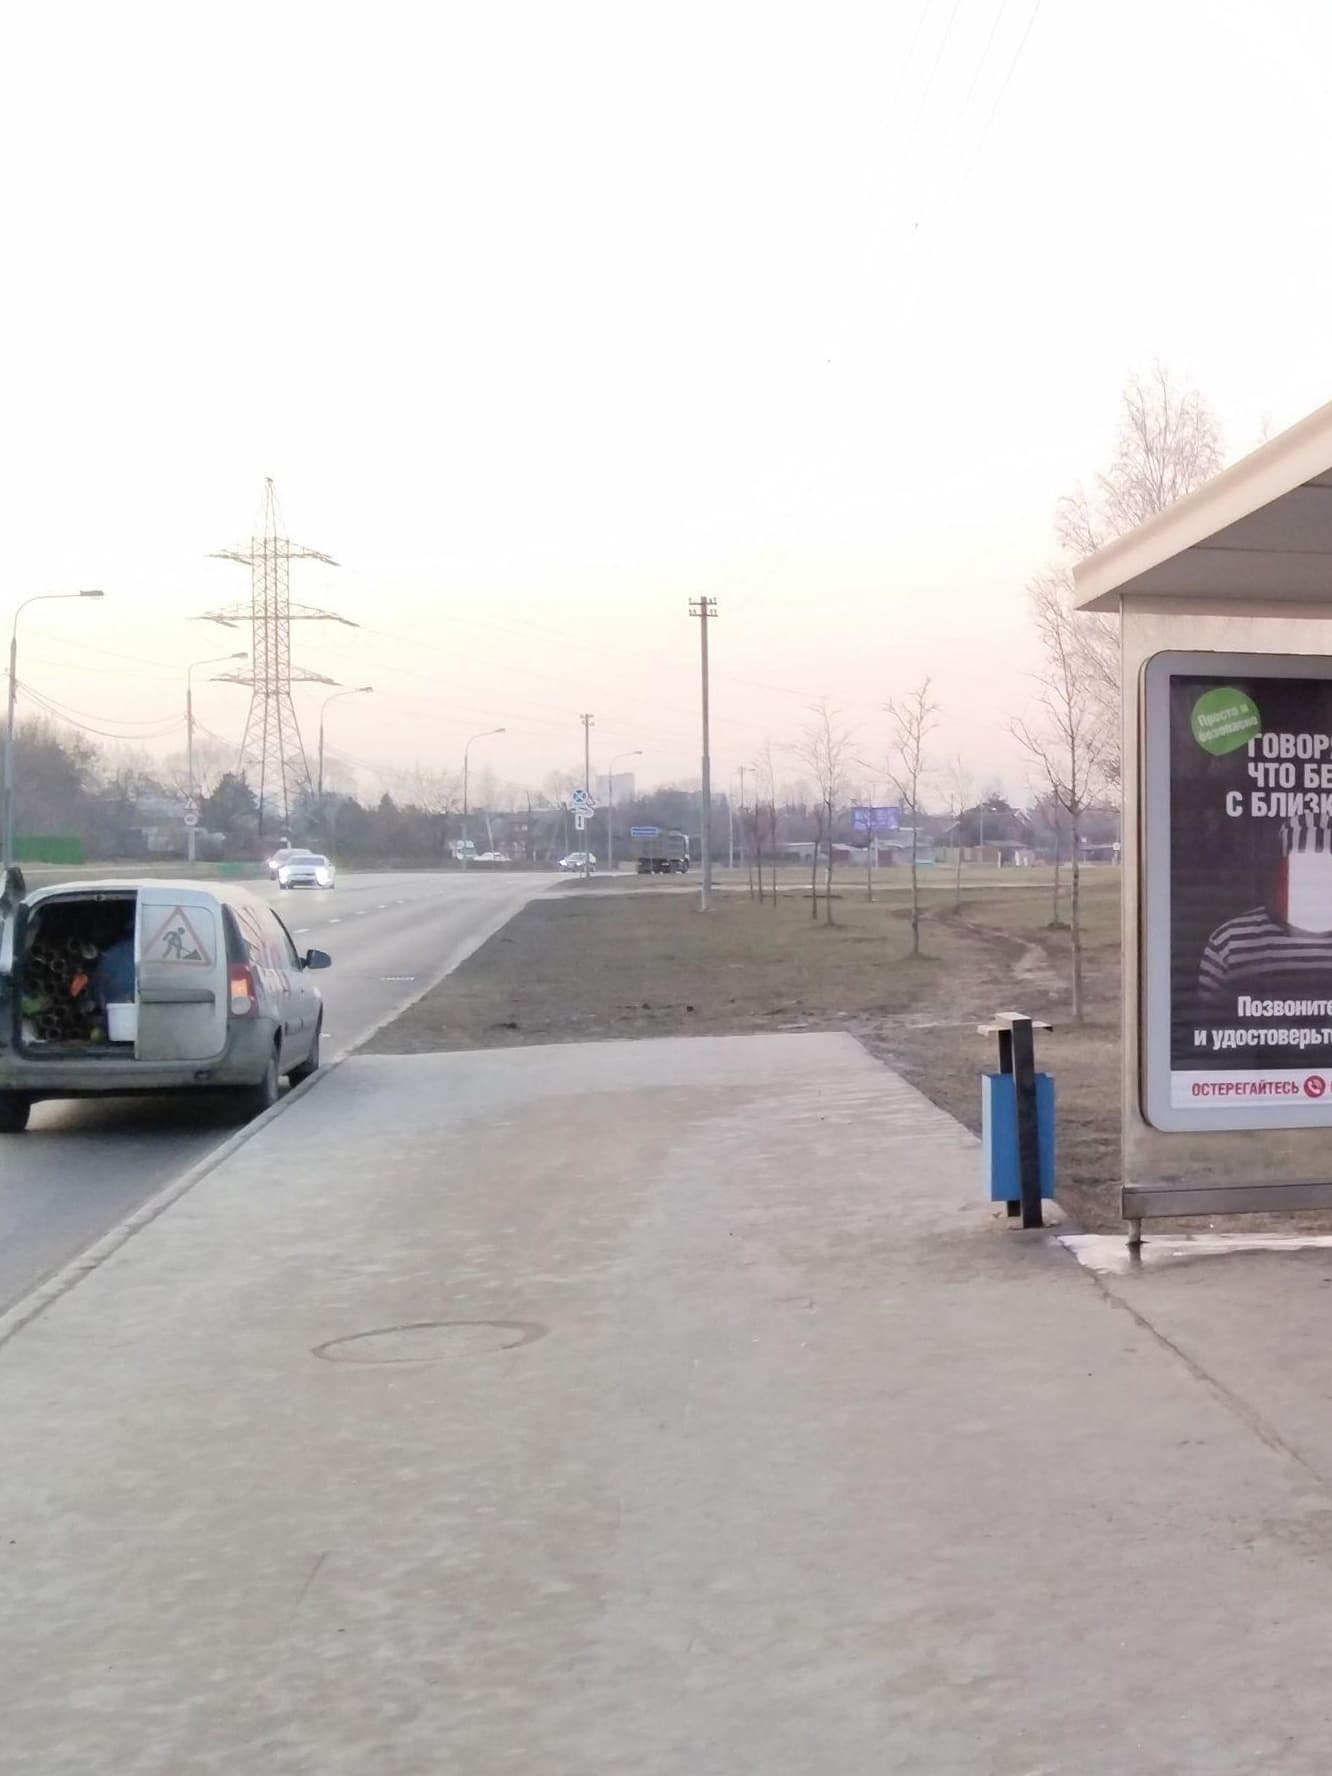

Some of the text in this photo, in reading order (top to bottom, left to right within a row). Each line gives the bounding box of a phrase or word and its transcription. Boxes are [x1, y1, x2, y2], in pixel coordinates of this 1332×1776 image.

[1248, 762, 1296, 789] ЧТО
[1226, 790, 1243, 818] С
[1194, 1029, 1206, 1046] и
[1191, 1079, 1299, 1097] ОСТЕРЕГАЙТЕСЬ
